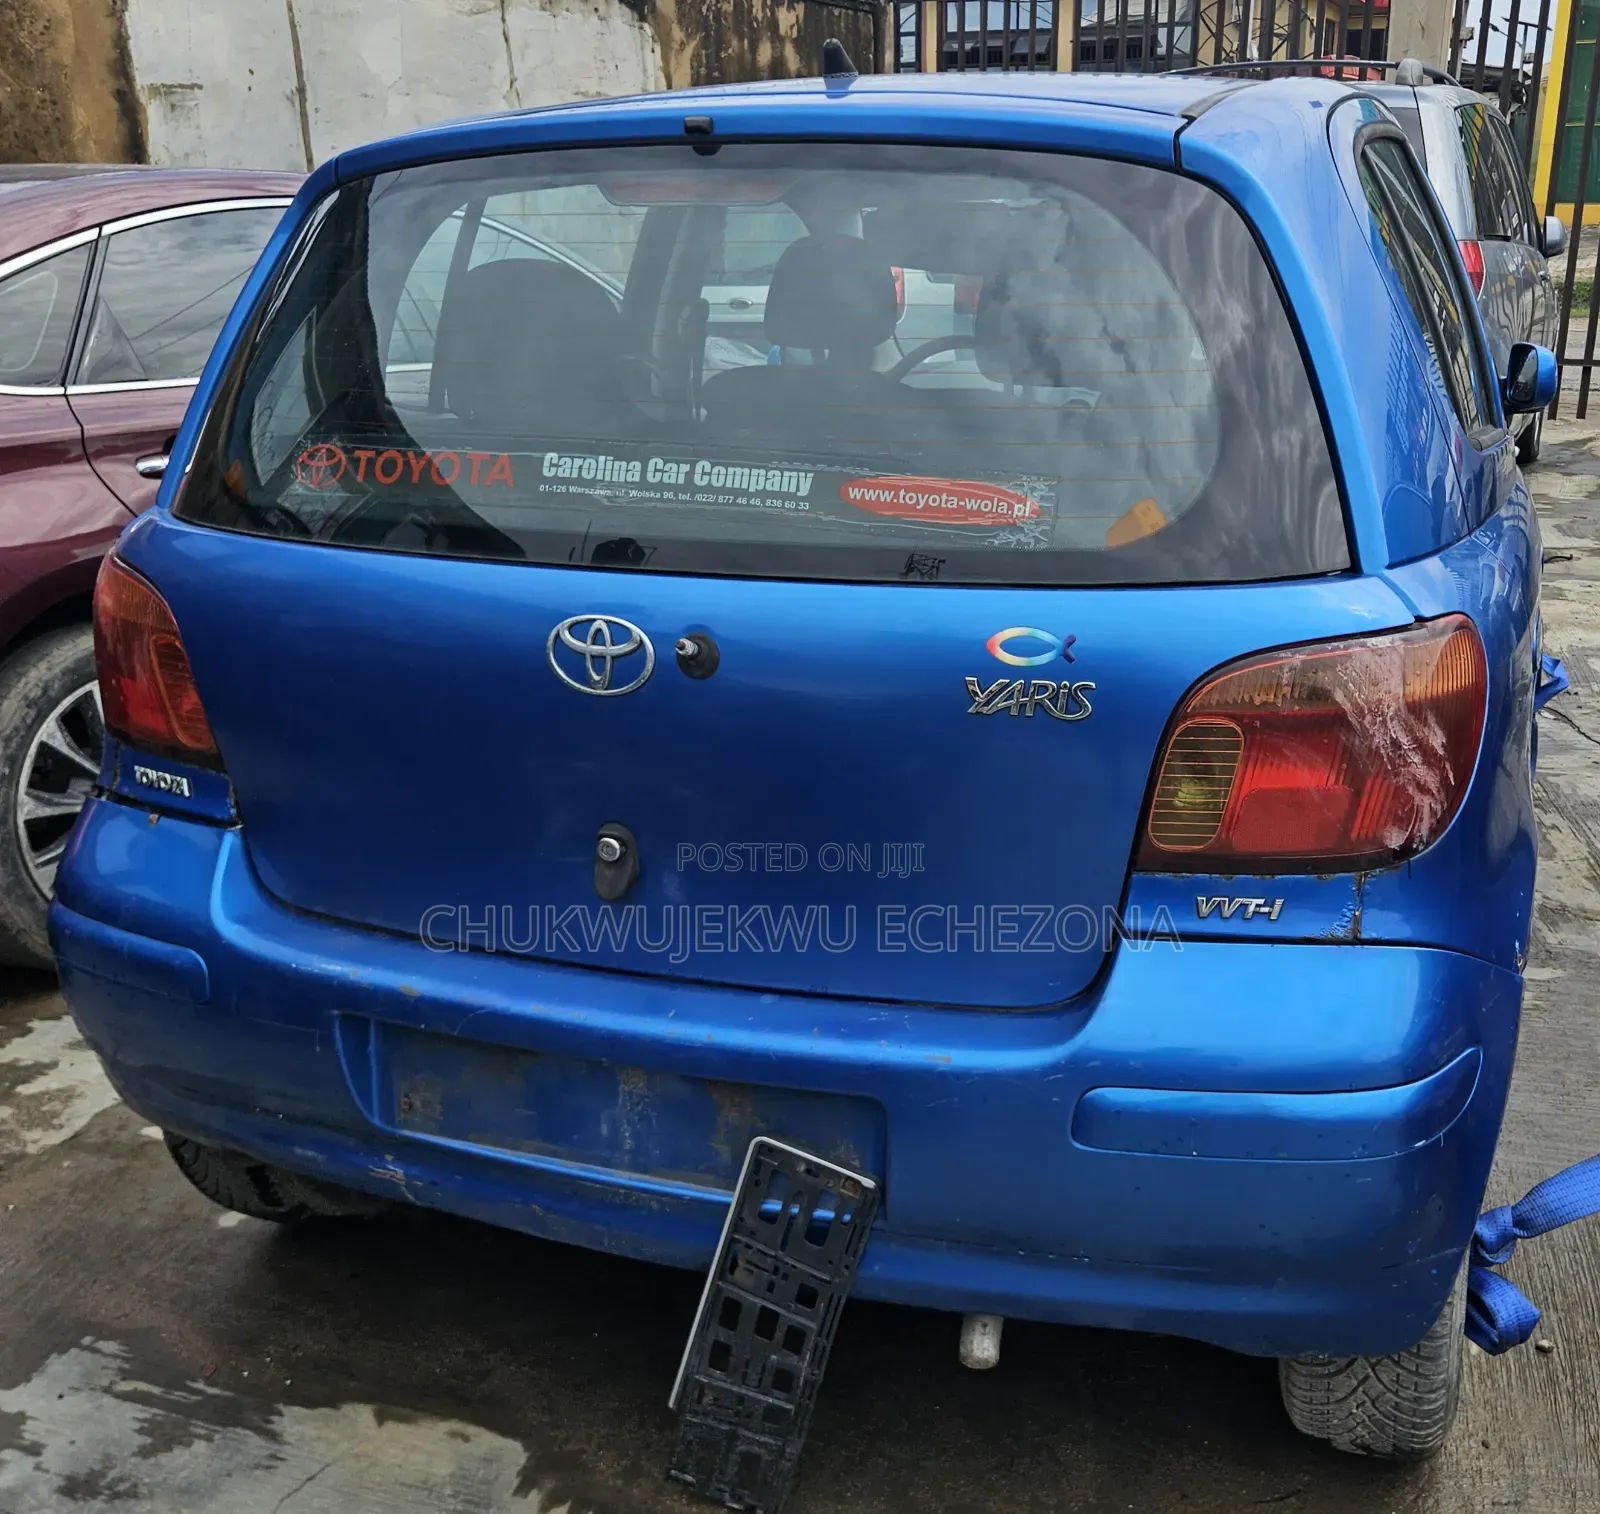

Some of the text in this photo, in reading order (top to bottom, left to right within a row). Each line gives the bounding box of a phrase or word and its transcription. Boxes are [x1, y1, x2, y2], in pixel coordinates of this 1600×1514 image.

[354, 449, 514, 488] TOYOTA
[542, 452, 814, 497] Carolina Car Company
[539, 484, 567, 493] 01-126
[628, 489, 661, 499] Wolska
[663, 491, 676, 500] 96,
[678, 492, 692, 501] tel.
[694, 493, 716, 502] /022/
[717, 494, 734, 504] 877
[736, 496, 748, 505] 46
[750, 497, 763, 507] 46,
[765, 499, 782, 508] 836
[784, 501, 796, 509] 60
[798, 502, 810, 510] 33
[848, 485, 1031, 517] www.toyota-wola.pl
